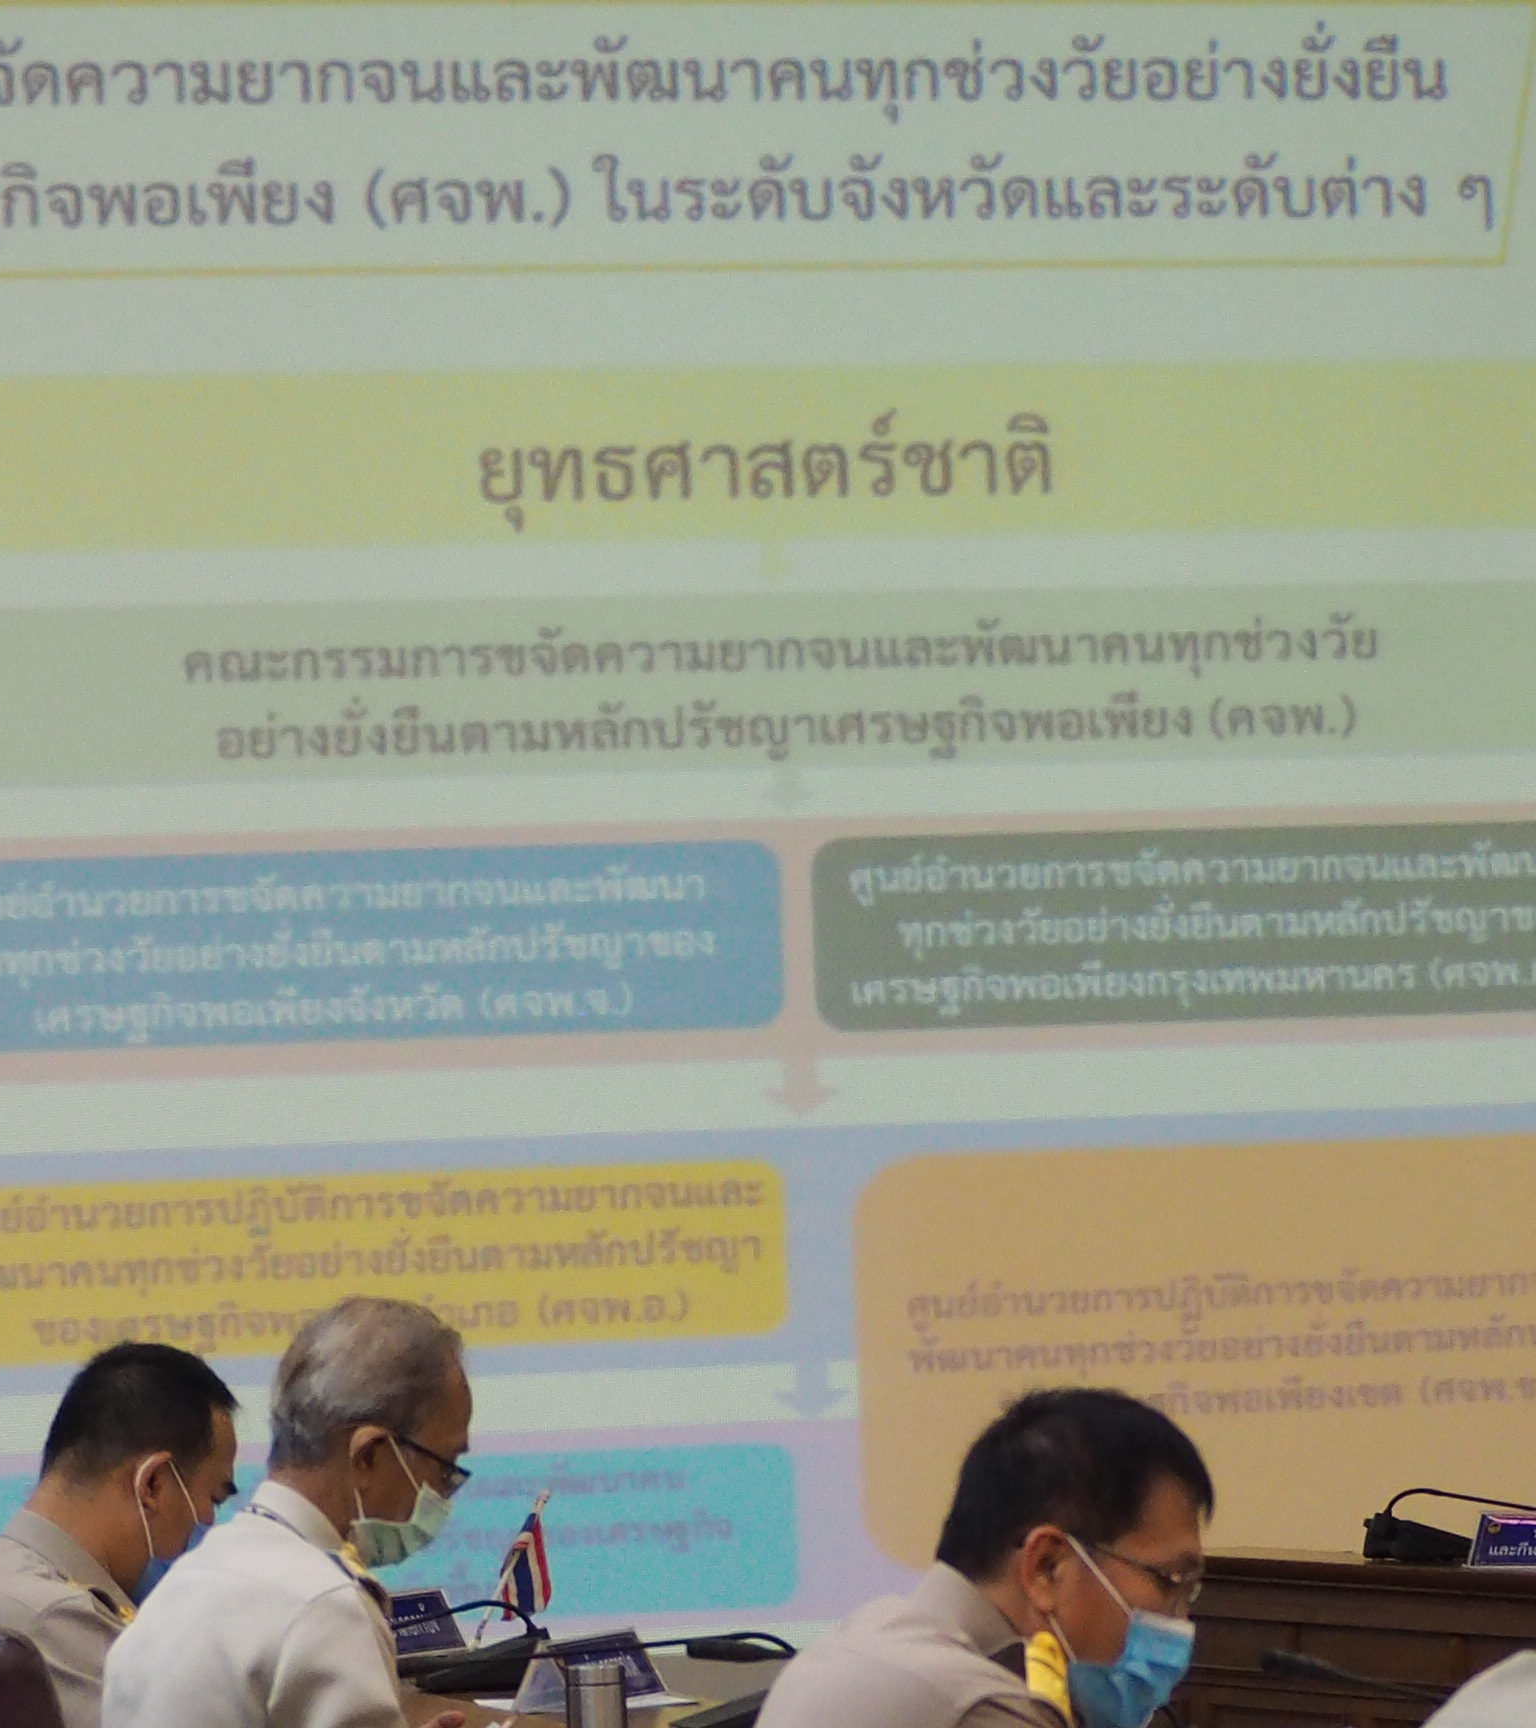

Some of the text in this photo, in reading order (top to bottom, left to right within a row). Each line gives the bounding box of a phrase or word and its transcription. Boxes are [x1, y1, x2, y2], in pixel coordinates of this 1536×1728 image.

[368, 168, 573, 230] (ศจพ.)
[593, 154, 1430, 227] ในระดับจังหวัดและระดับต่าง
[479, 409, 1053, 532] ยุทธศาสตร์ชาติ
[184, 614, 1378, 680] คณะกรรมการขจัดความยากจนและพัฒนาคนทุกช่วงวัย
[217, 691, 1192, 761] อย่างยั่งยืนตามหลักปรัชญาเศรษฐกิจพอเพียง
